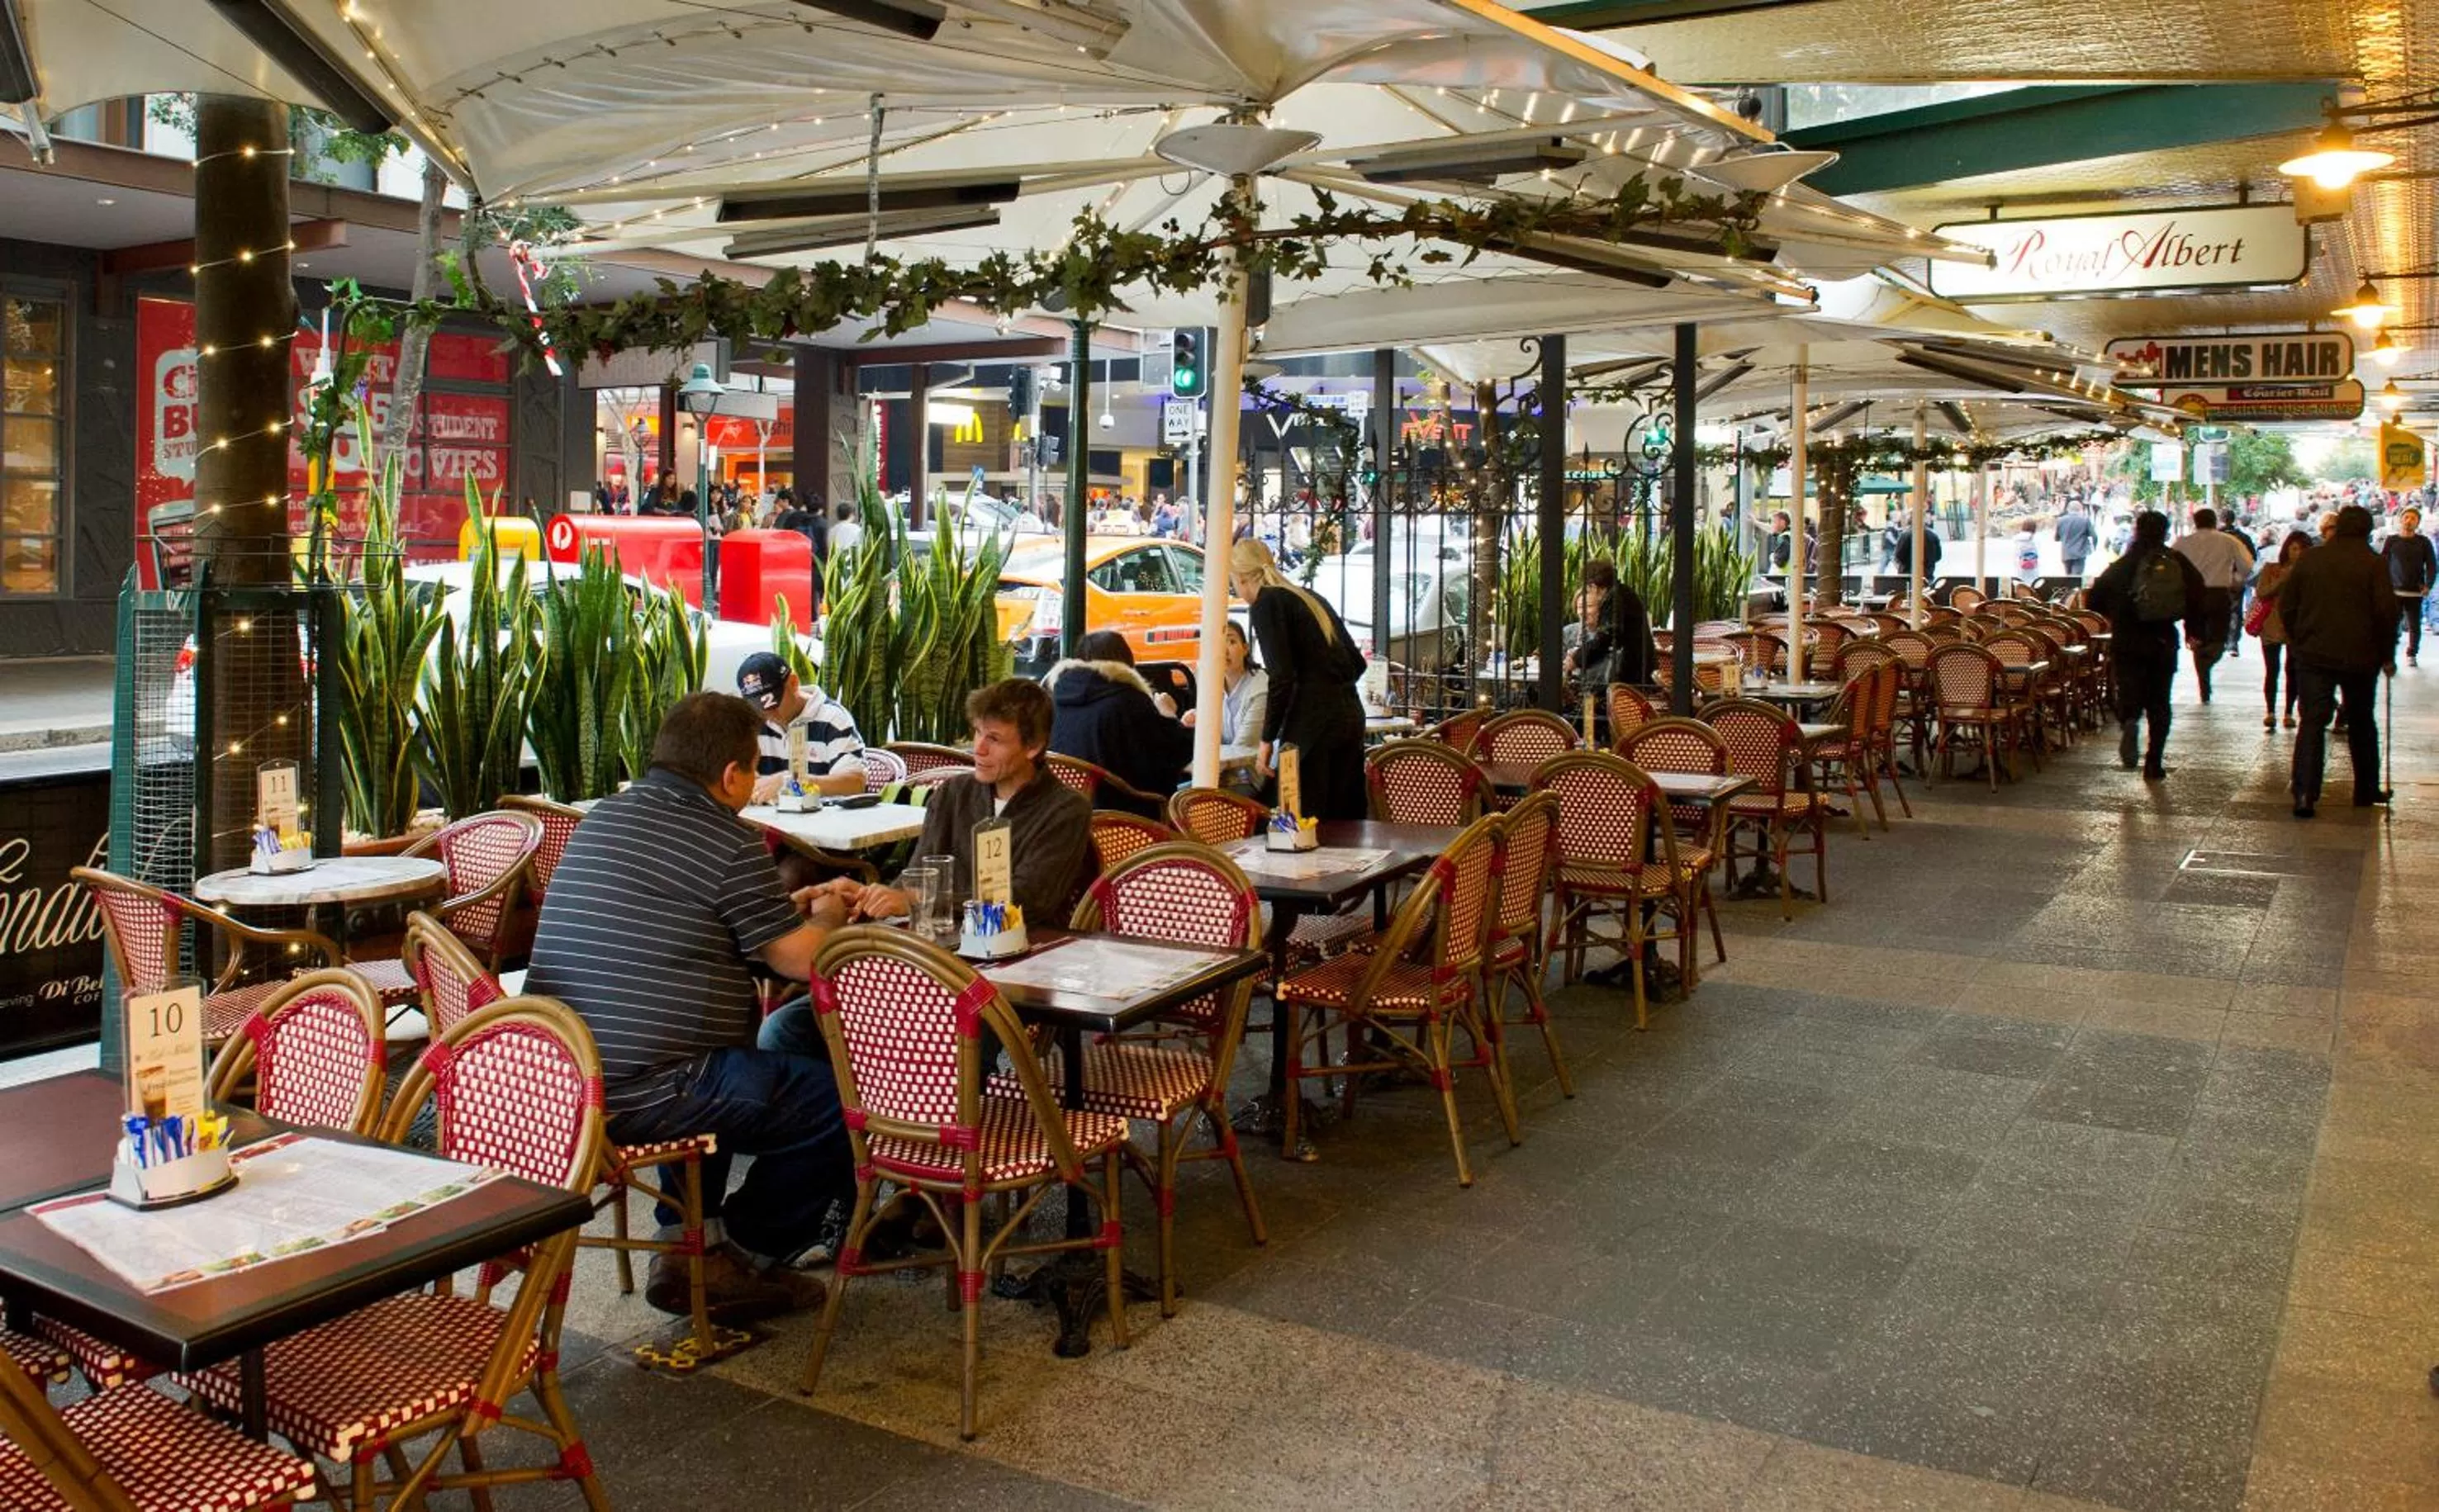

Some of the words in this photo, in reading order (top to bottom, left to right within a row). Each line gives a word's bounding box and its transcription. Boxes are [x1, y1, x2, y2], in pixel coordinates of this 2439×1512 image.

[2007, 228, 2119, 282] Royal
[2109, 220, 2246, 280] Albert
[2165, 344, 2252, 379] MENS
[2261, 342, 2341, 377] HAIR
[1169, 405, 1190, 415] ONE
[1169, 418, 1189, 427] WAY
[761, 692, 778, 709] 2
[272, 775, 287, 793] 11
[986, 837, 1003, 859] 12
[39, 980, 69, 1000] Di
[149, 1002, 183, 1038] 10
